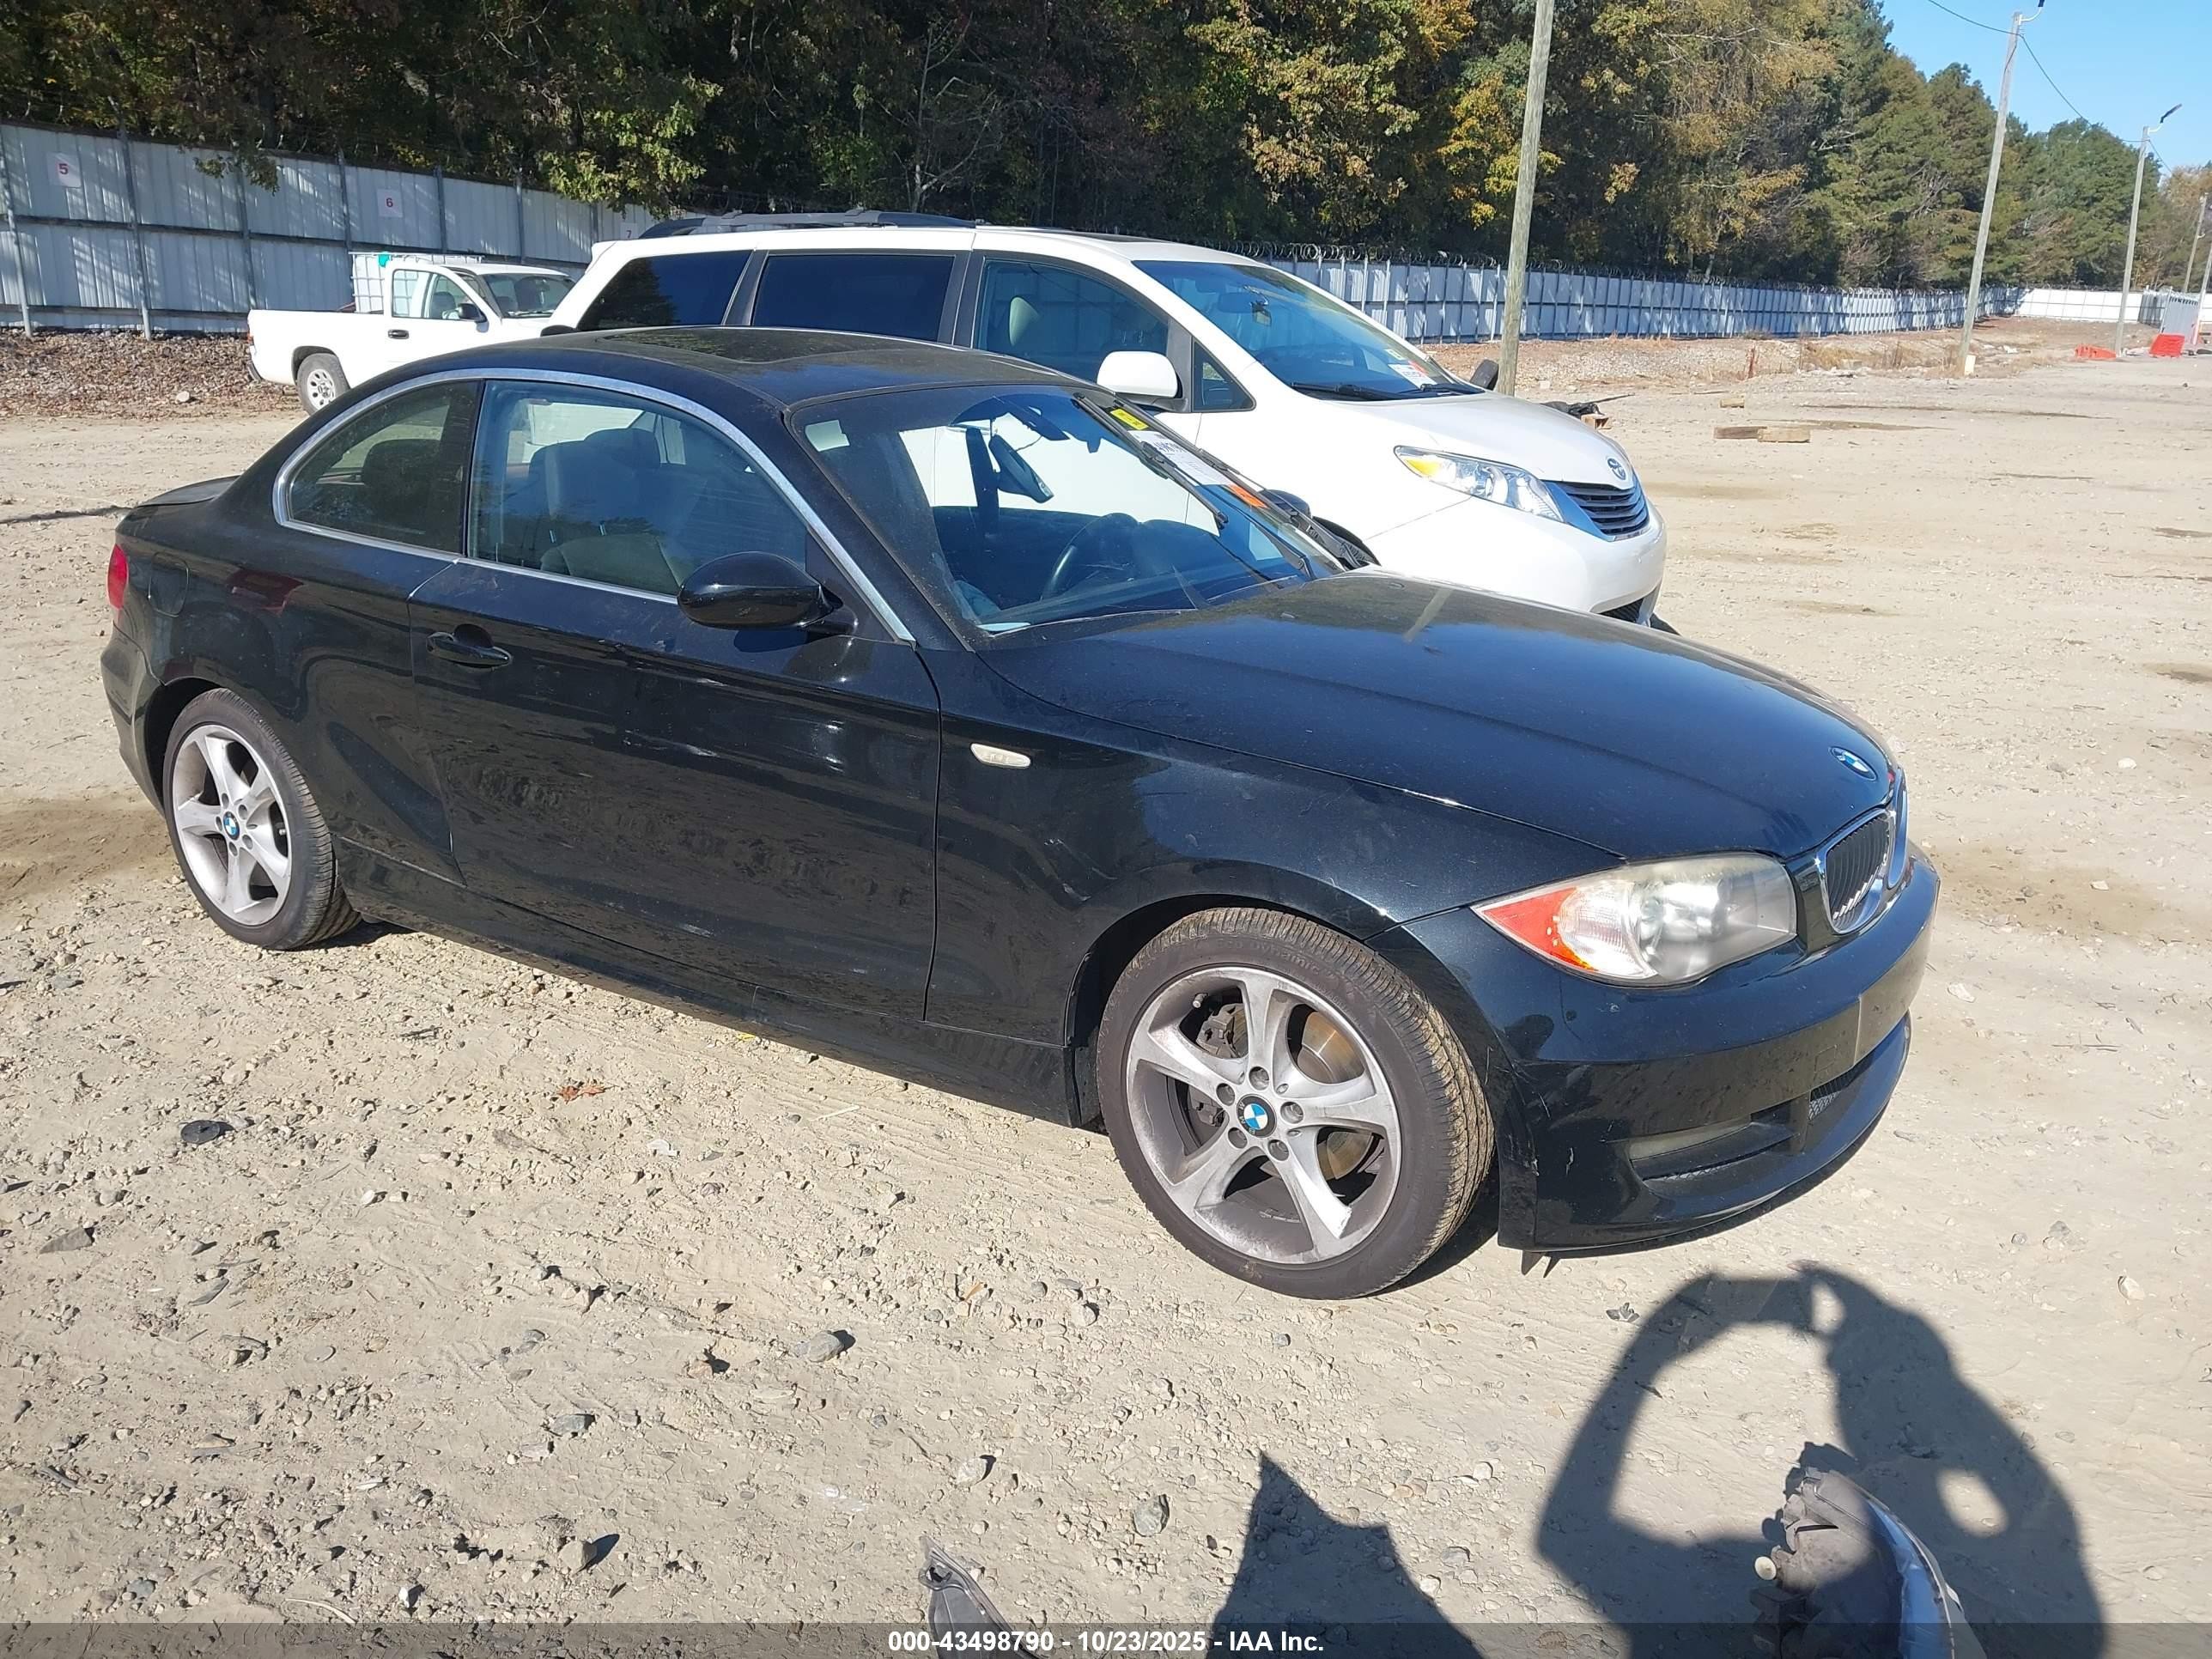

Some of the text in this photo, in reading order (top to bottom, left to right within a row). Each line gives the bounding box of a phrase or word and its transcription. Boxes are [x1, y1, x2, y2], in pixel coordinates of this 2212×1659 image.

[58, 163, 69, 175] 5
[386, 198, 393, 208] 6
[626, 229, 632, 239] 7
